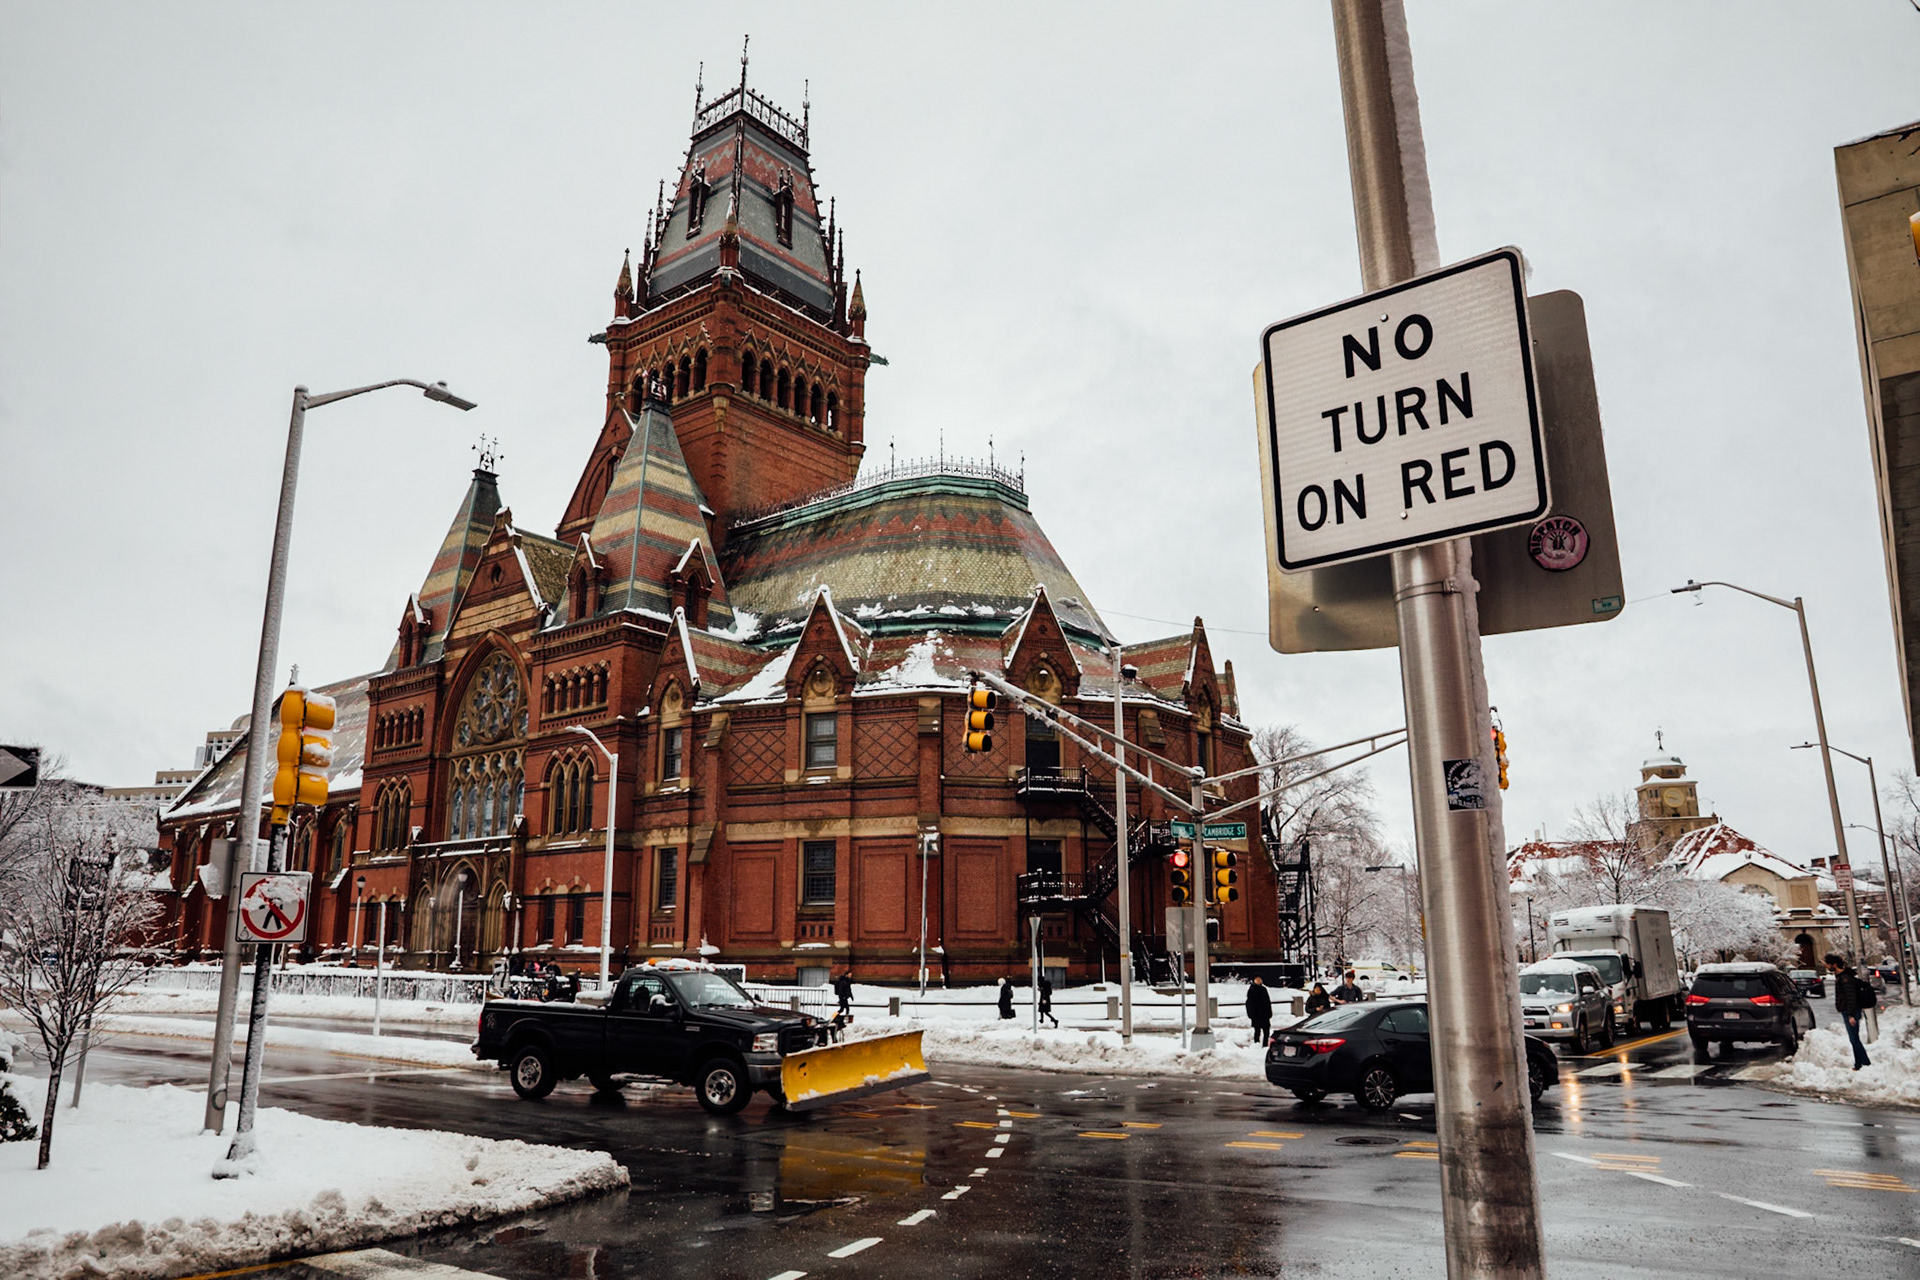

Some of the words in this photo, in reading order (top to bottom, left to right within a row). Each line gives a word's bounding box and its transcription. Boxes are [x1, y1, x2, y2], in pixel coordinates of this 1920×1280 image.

[1342, 313, 1434, 379] NO
[1321, 371, 1474, 453] TURN
[1297, 473, 1367, 532] ON
[1400, 439, 1517, 510] RED
[1530, 518, 1582, 556] DISPATCH
[1204, 826, 1234, 837] CAMBRIDGE
[1237, 825, 1245, 835] ST
